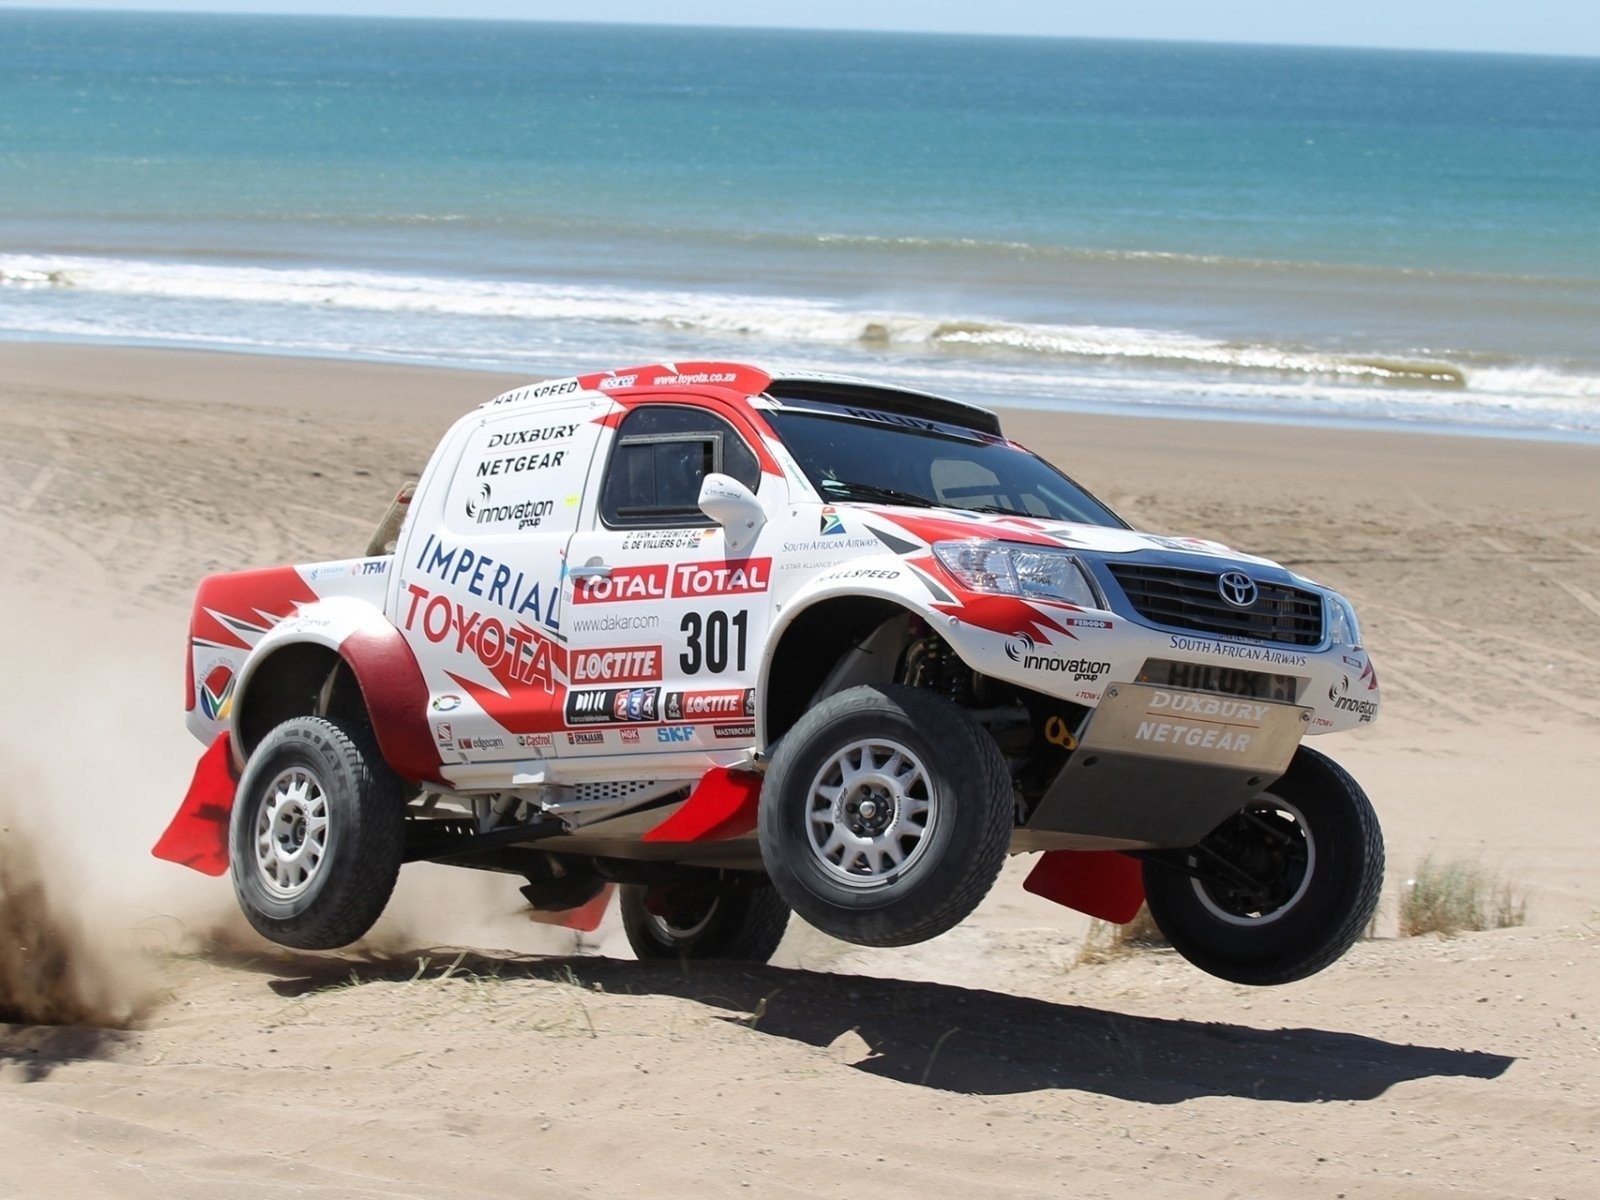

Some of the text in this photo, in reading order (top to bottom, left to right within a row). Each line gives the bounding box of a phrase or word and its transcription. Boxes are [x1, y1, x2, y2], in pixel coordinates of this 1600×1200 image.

[653, 371, 736, 386] www.toyota.co.za
[487, 423, 581, 448] DUXBURY
[476, 451, 565, 477] NETGEAR
[476, 499, 554, 524] innovation
[518, 518, 541, 530] group
[631, 540, 642, 549] DE
[643, 539, 675, 549] VILLIERS
[363, 561, 387, 575] TFM
[416, 533, 560, 631] IMPERIAL
[677, 564, 767, 594] TOTAL
[572, 613, 660, 633] www.dakar.com
[404, 583, 556, 696] TOYOTA
[679, 609, 749, 676] 301
[1169, 634, 1212, 654] SOUTH
[1211, 642, 1262, 660] AFRICAN
[1260, 648, 1307, 667] AIRWAYS
[574, 650, 657, 681] LOCTITE
[1024, 655, 1112, 675] innovation
[1073, 672, 1099, 682] group
[1167, 662, 1259, 698] HILUX
[617, 694, 655, 716] 2 3 4
[686, 694, 740, 713] LOCTITE
[1148, 691, 1271, 721] DUXBURY
[525, 734, 552, 746] Castrol
[621, 730, 640, 740] NGK
[656, 726, 695, 743] SKF
[715, 727, 755, 736] MASTERCRAFT
[1135, 721, 1252, 753] NETGEAR
[473, 737, 504, 750] edgecam
